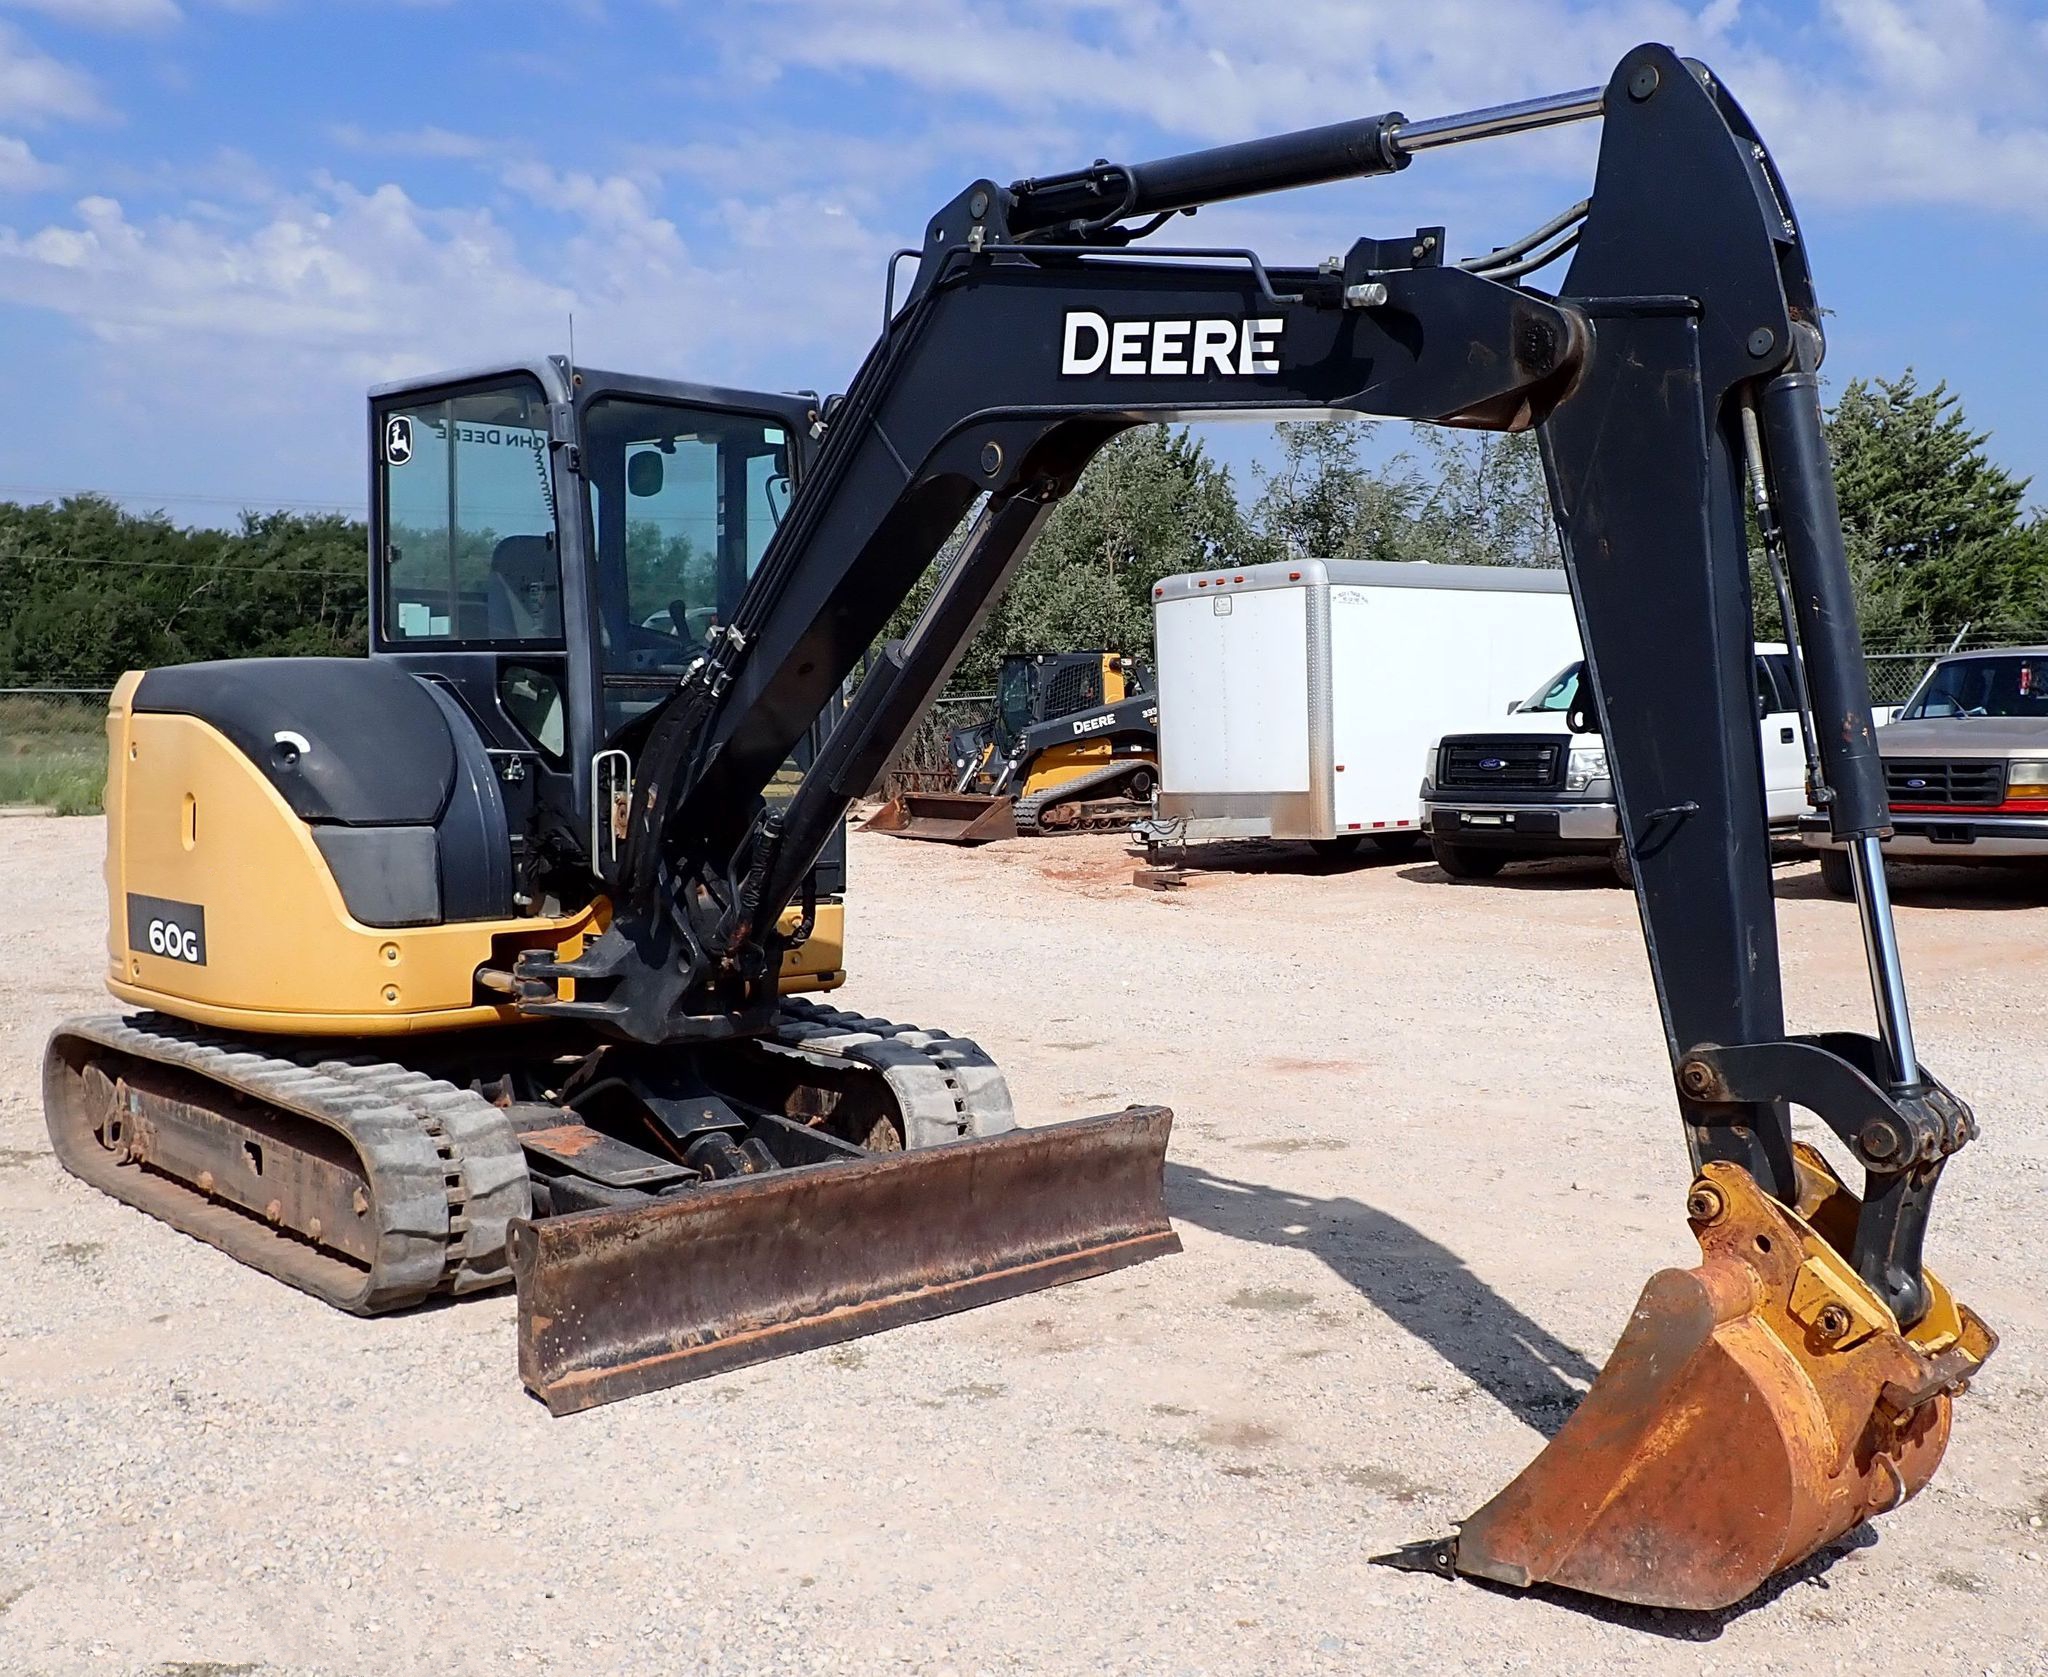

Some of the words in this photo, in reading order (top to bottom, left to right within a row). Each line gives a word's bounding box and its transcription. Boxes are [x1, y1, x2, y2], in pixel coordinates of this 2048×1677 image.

[1062, 312, 1284, 375] DEERE
[1072, 713, 1116, 735] DEERE
[149, 919, 198, 962] 60G
